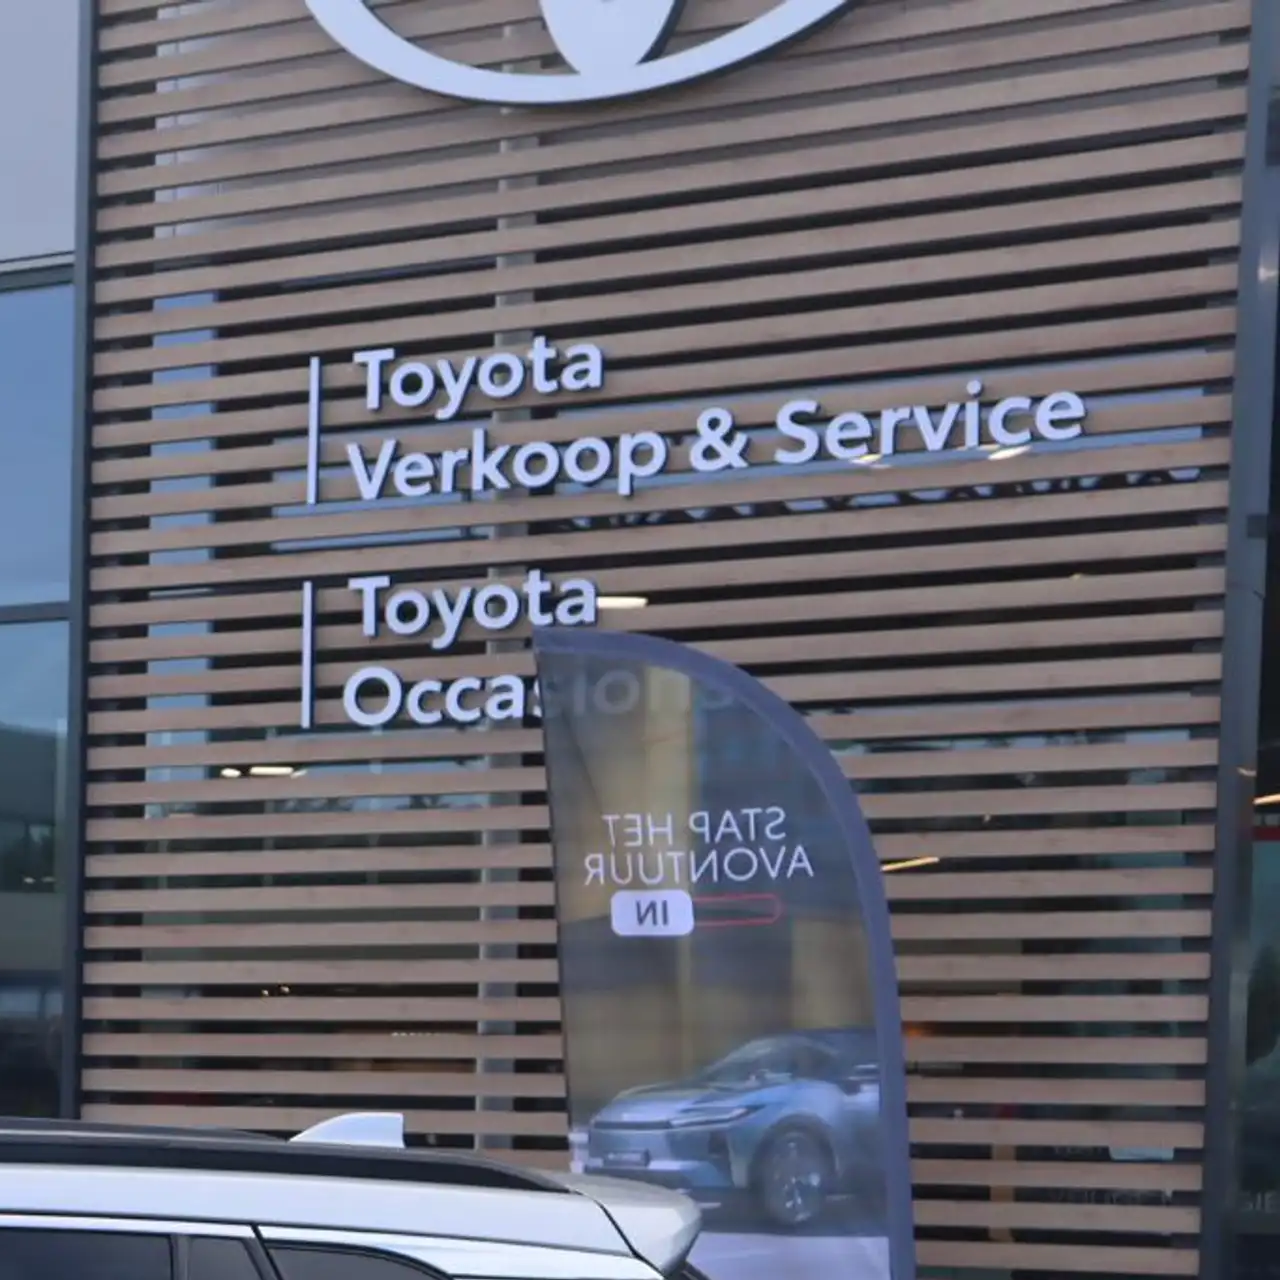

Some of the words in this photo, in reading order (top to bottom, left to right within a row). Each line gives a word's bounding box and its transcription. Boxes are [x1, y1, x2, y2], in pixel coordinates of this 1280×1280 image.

[352, 335, 604, 420] Toyota
[346, 427, 668, 501] Verkoop
[688, 406, 749, 472] &
[773, 379, 1087, 465] Service
[347, 568, 597, 650] Toyota
